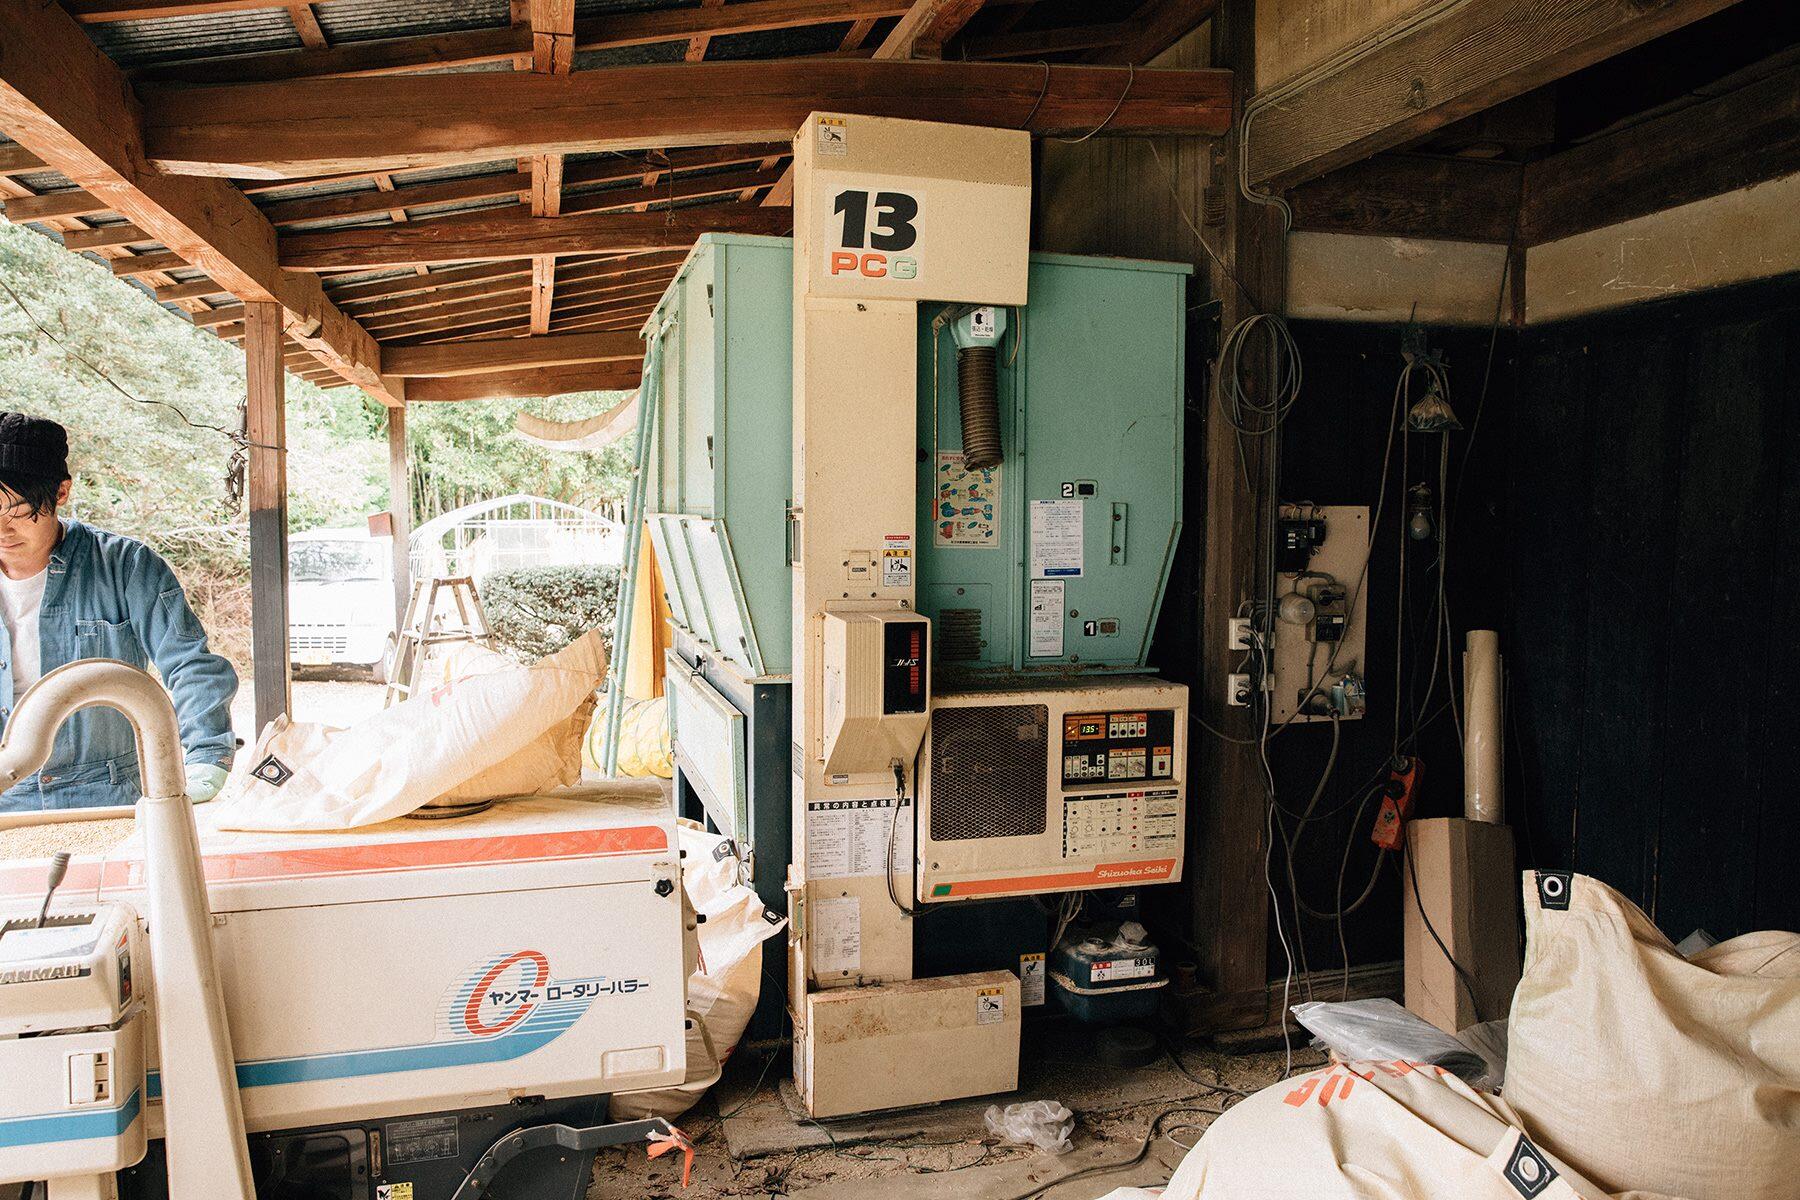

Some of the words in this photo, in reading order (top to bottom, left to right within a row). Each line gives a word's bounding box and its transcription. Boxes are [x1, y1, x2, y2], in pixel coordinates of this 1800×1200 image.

[833, 189, 919, 252] 13
[831, 251, 918, 280] PCG
[1062, 483, 1073, 497] 2
[1085, 622, 1095, 635] 1
[1097, 867, 1143, 879] Shizuoka
[1143, 864, 1168, 875] Seiki
[489, 990, 539, 1006] ヤンマー
[546, 979, 649, 1001] ロータリーハラー
